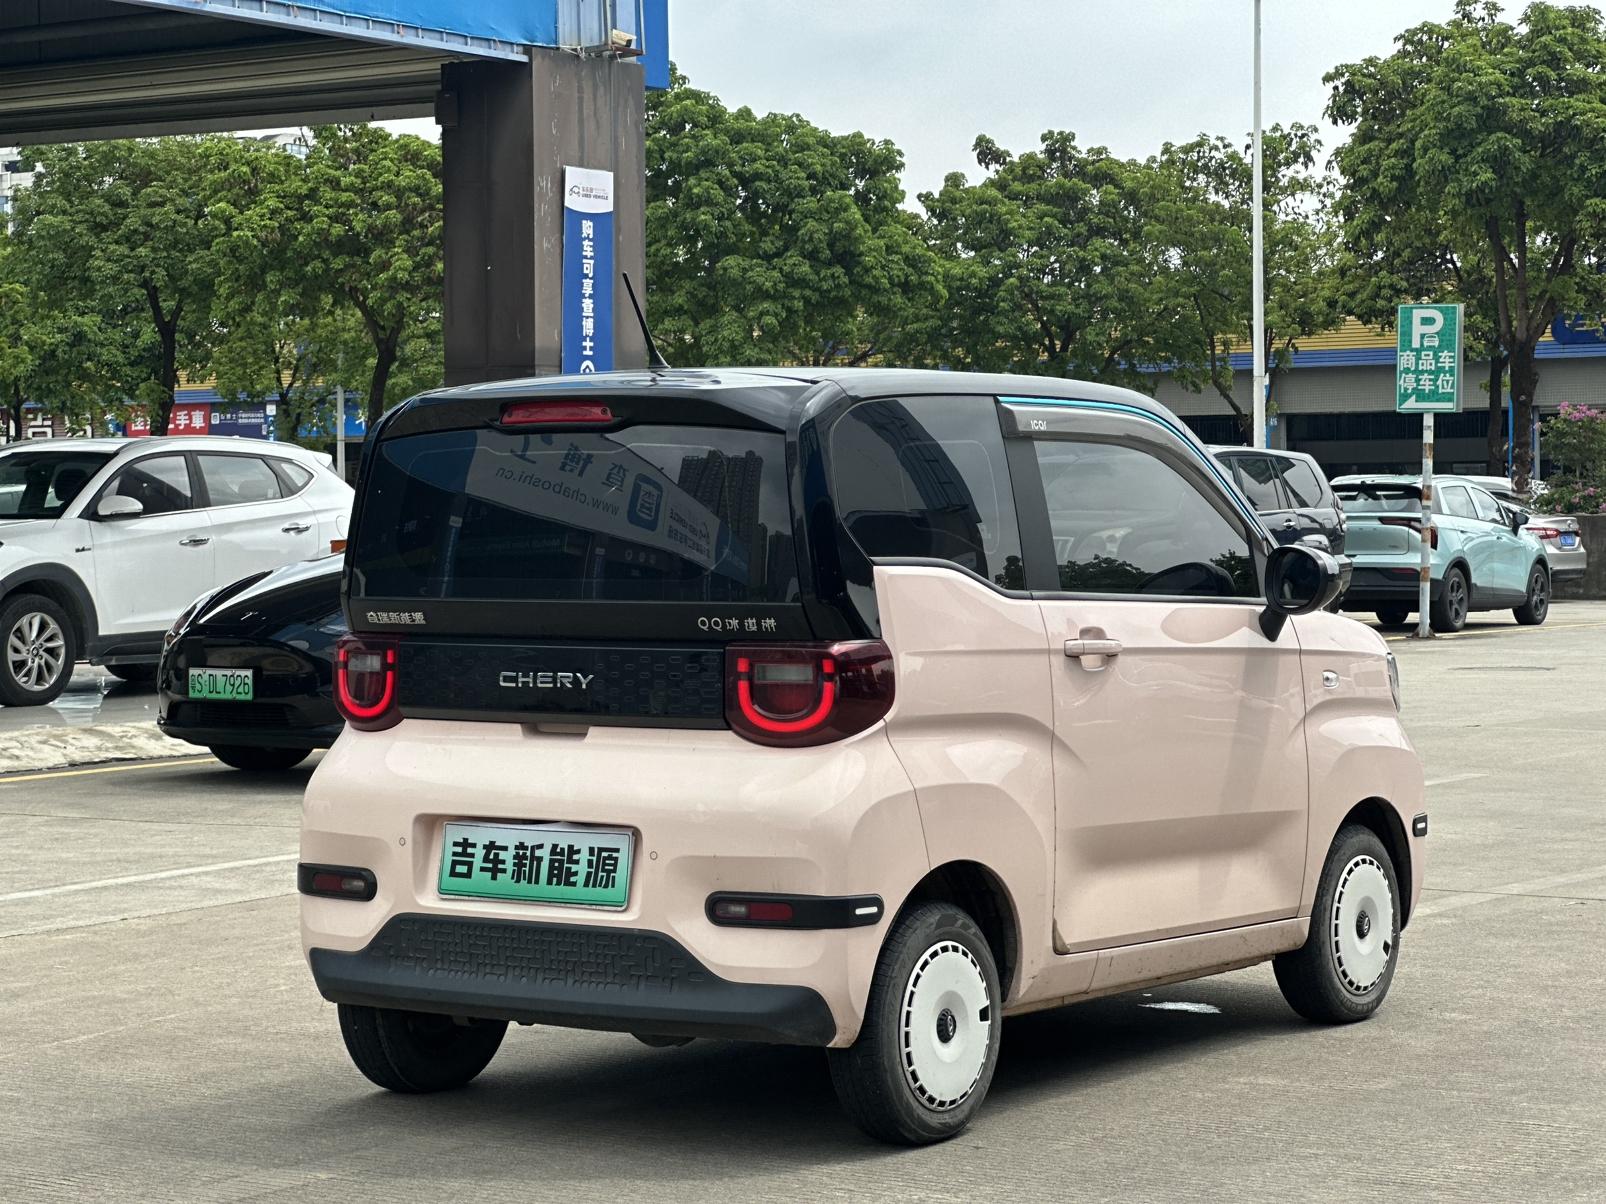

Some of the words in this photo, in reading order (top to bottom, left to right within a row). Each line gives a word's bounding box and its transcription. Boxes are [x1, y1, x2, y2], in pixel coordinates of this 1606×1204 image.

[581, 219, 594, 356] 购车可享查博士
[1411, 308, 1444, 348] P
[1399, 350, 1455, 371] 商品车
[1399, 373, 1455, 393] 停车位
[366, 611, 427, 625] 奇瑞新能源
[499, 671, 595, 689] CHERY
[448, 837, 621, 889] 吉车新能源
